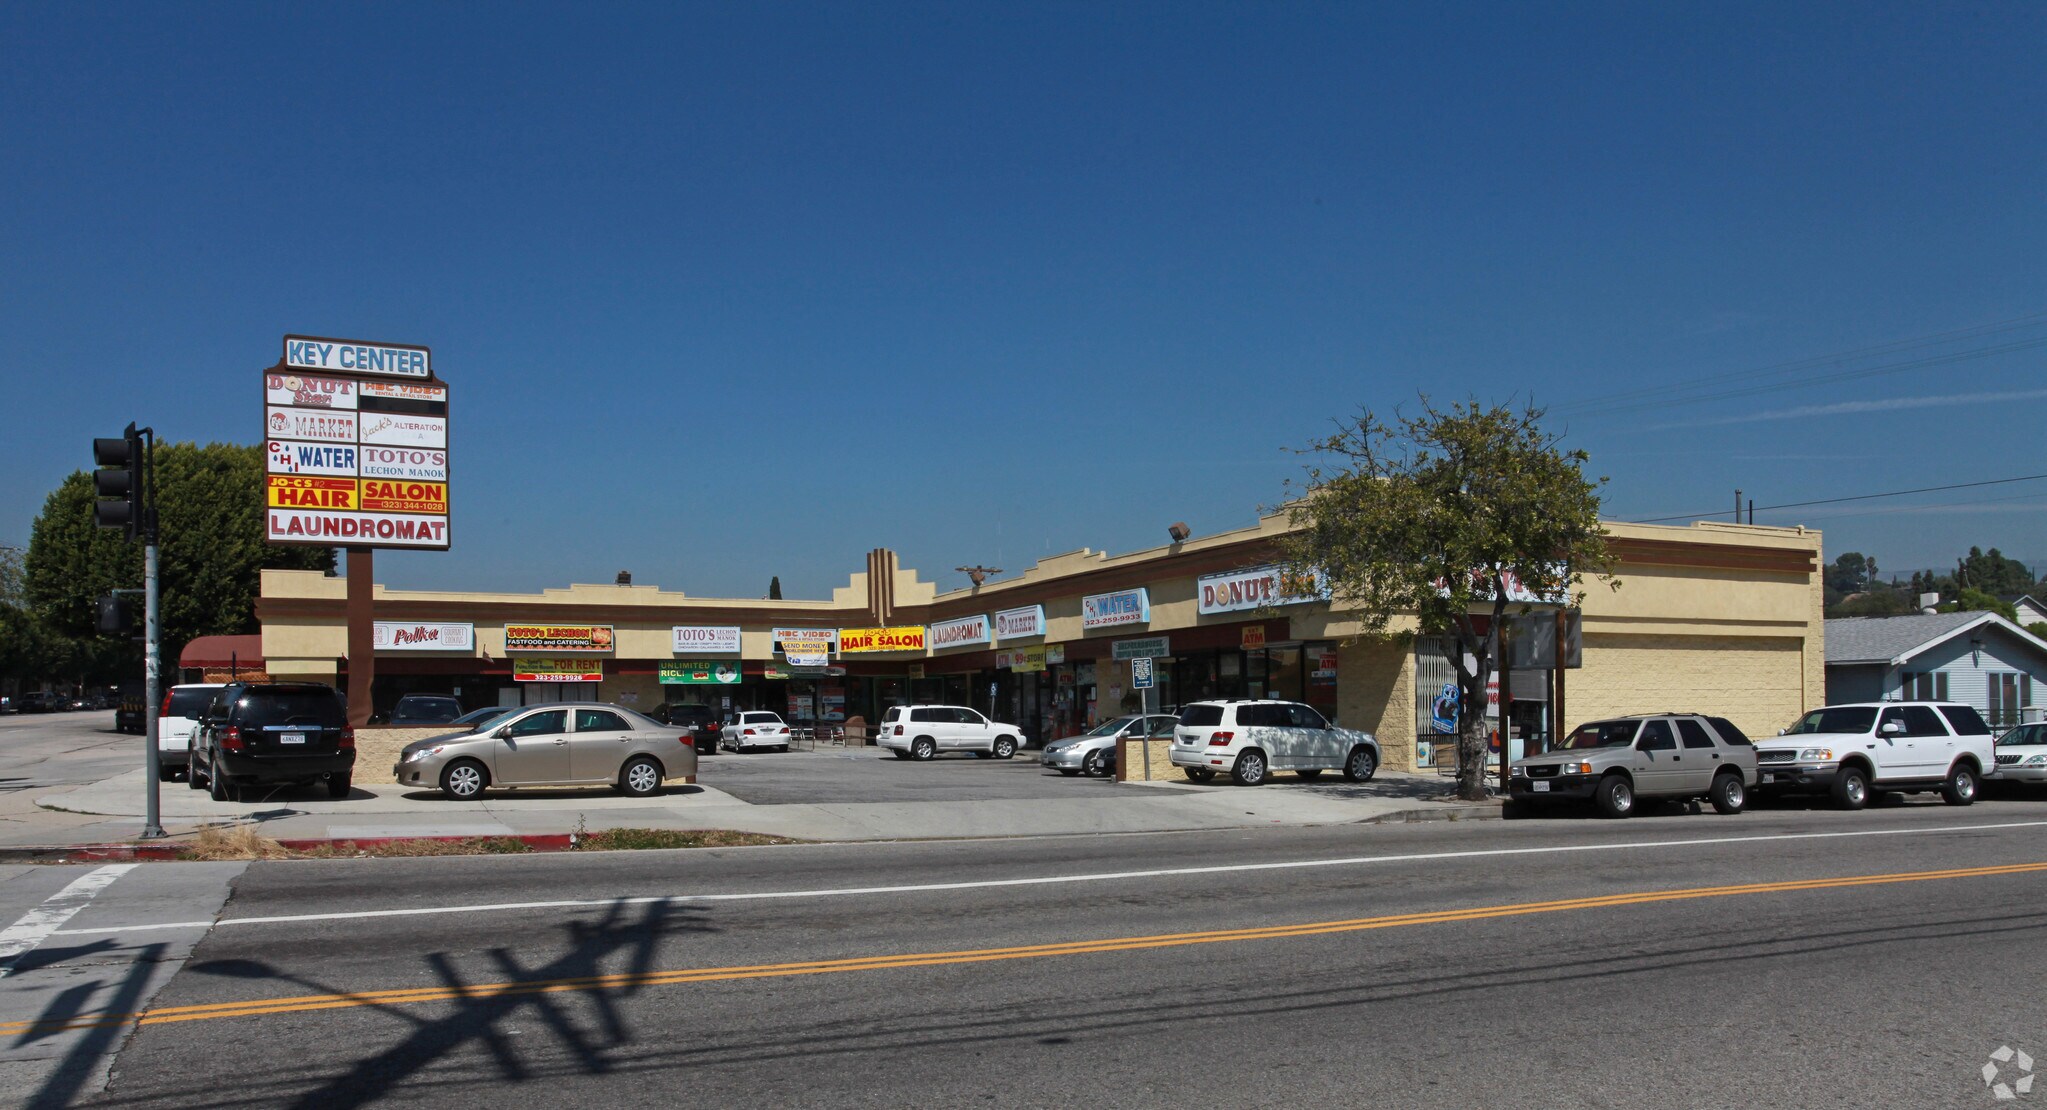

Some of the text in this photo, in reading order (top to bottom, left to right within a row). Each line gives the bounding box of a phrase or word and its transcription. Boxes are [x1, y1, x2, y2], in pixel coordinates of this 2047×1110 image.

[289, 341, 425, 374] KEY CENTER
[269, 375, 353, 394] DONUT
[400, 385, 442, 395] VIDEO
[295, 416, 353, 438] MARKET
[361, 417, 443, 441] Jack's ALTERATION
[298, 446, 355, 468] WATER
[365, 449, 445, 466] TOTO'S
[365, 466, 444, 478] LECHON MANOK
[270, 478, 325, 488] JO-C'S #2
[365, 482, 442, 501] SALON
[278, 488, 351, 508] HAIR
[381, 501, 443, 511] (323) 344-1028
[271, 515, 446, 541] LAUNDROMAT
[1203, 576, 1273, 608] DONUT
[1097, 593, 1140, 616] WATER
[1008, 615, 1036, 635] MARKET
[1085, 613, 1141, 626] 323-259-9933
[393, 626, 439, 646] Polka
[546, 627, 590, 638] LECHON
[676, 629, 715, 641] TOTO'S
[777, 630, 799, 638] HBC
[933, 622, 983, 645] LAUNDROMAT
[1243, 633, 1264, 644] ATM
[840, 634, 923, 651] HAIR SALON
[554, 660, 575, 670] FOR
[576, 660, 600, 670] RENT
[1320, 659, 1337, 669] ATM
